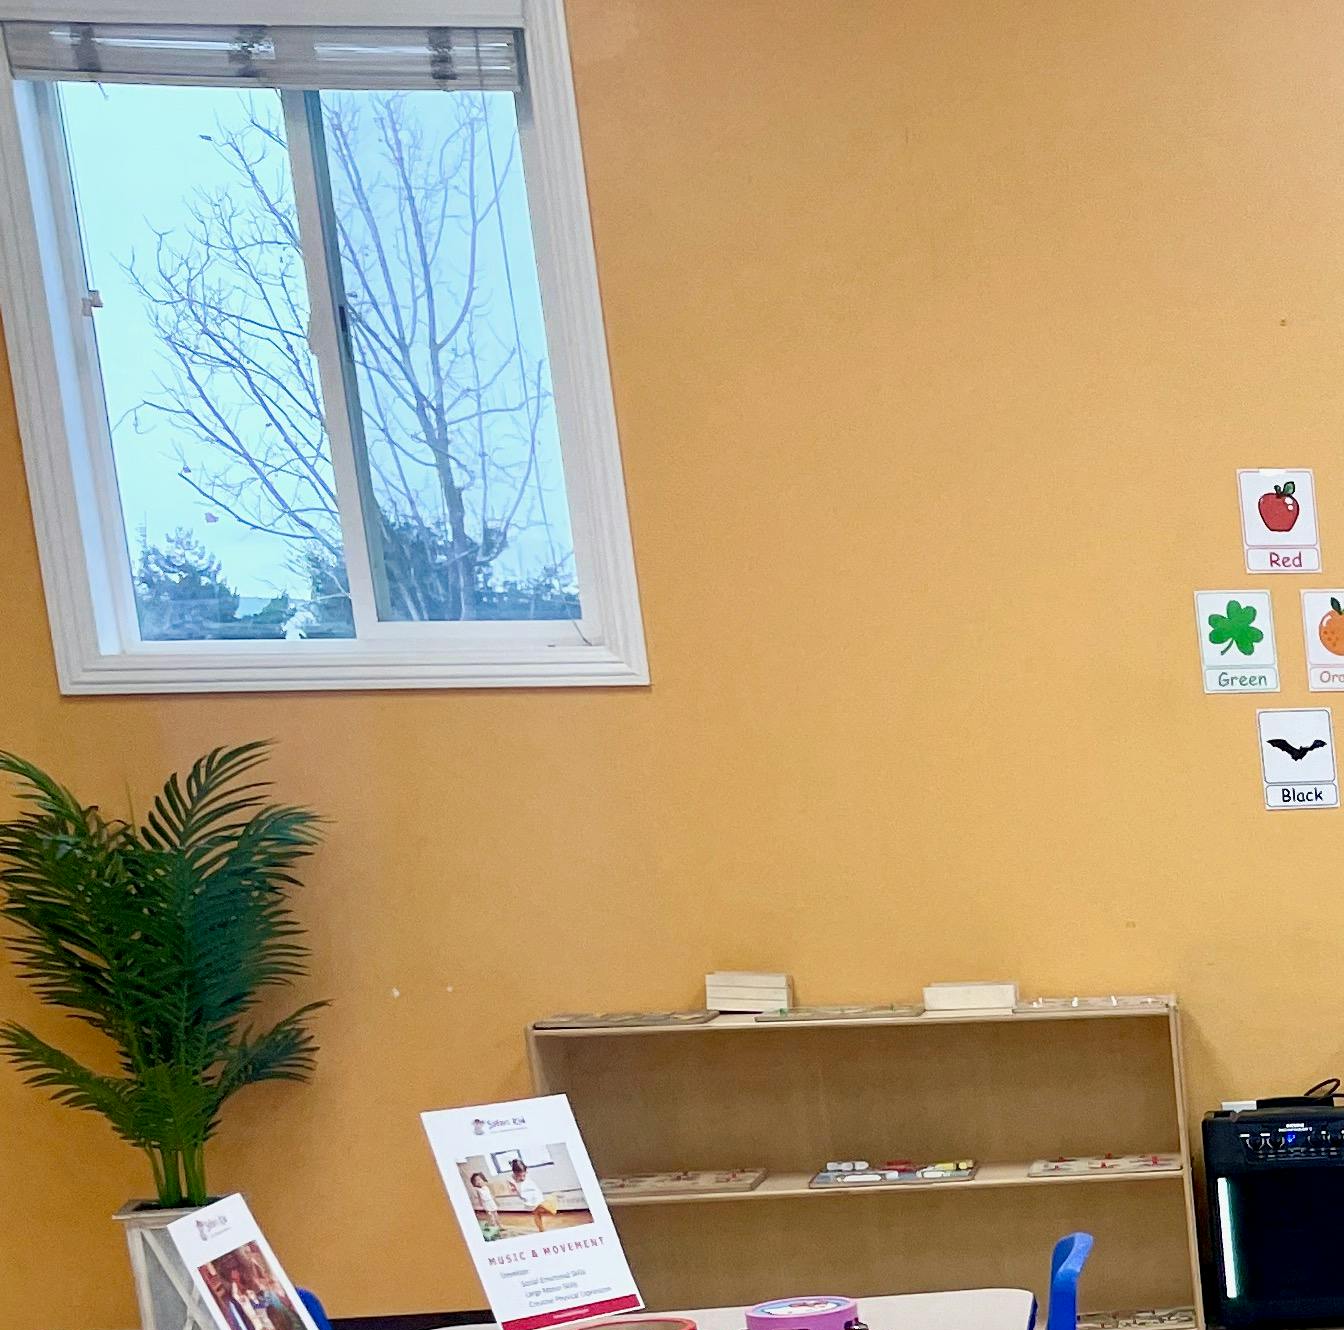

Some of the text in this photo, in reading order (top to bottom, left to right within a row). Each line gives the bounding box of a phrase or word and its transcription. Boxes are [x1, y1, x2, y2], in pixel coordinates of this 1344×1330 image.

[1269, 552, 1302, 568] Red
[1218, 672, 1267, 688] Green
[1281, 787, 1324, 802] Black
[488, 1236, 604, 1266] MUSIC & MOVEMENT
